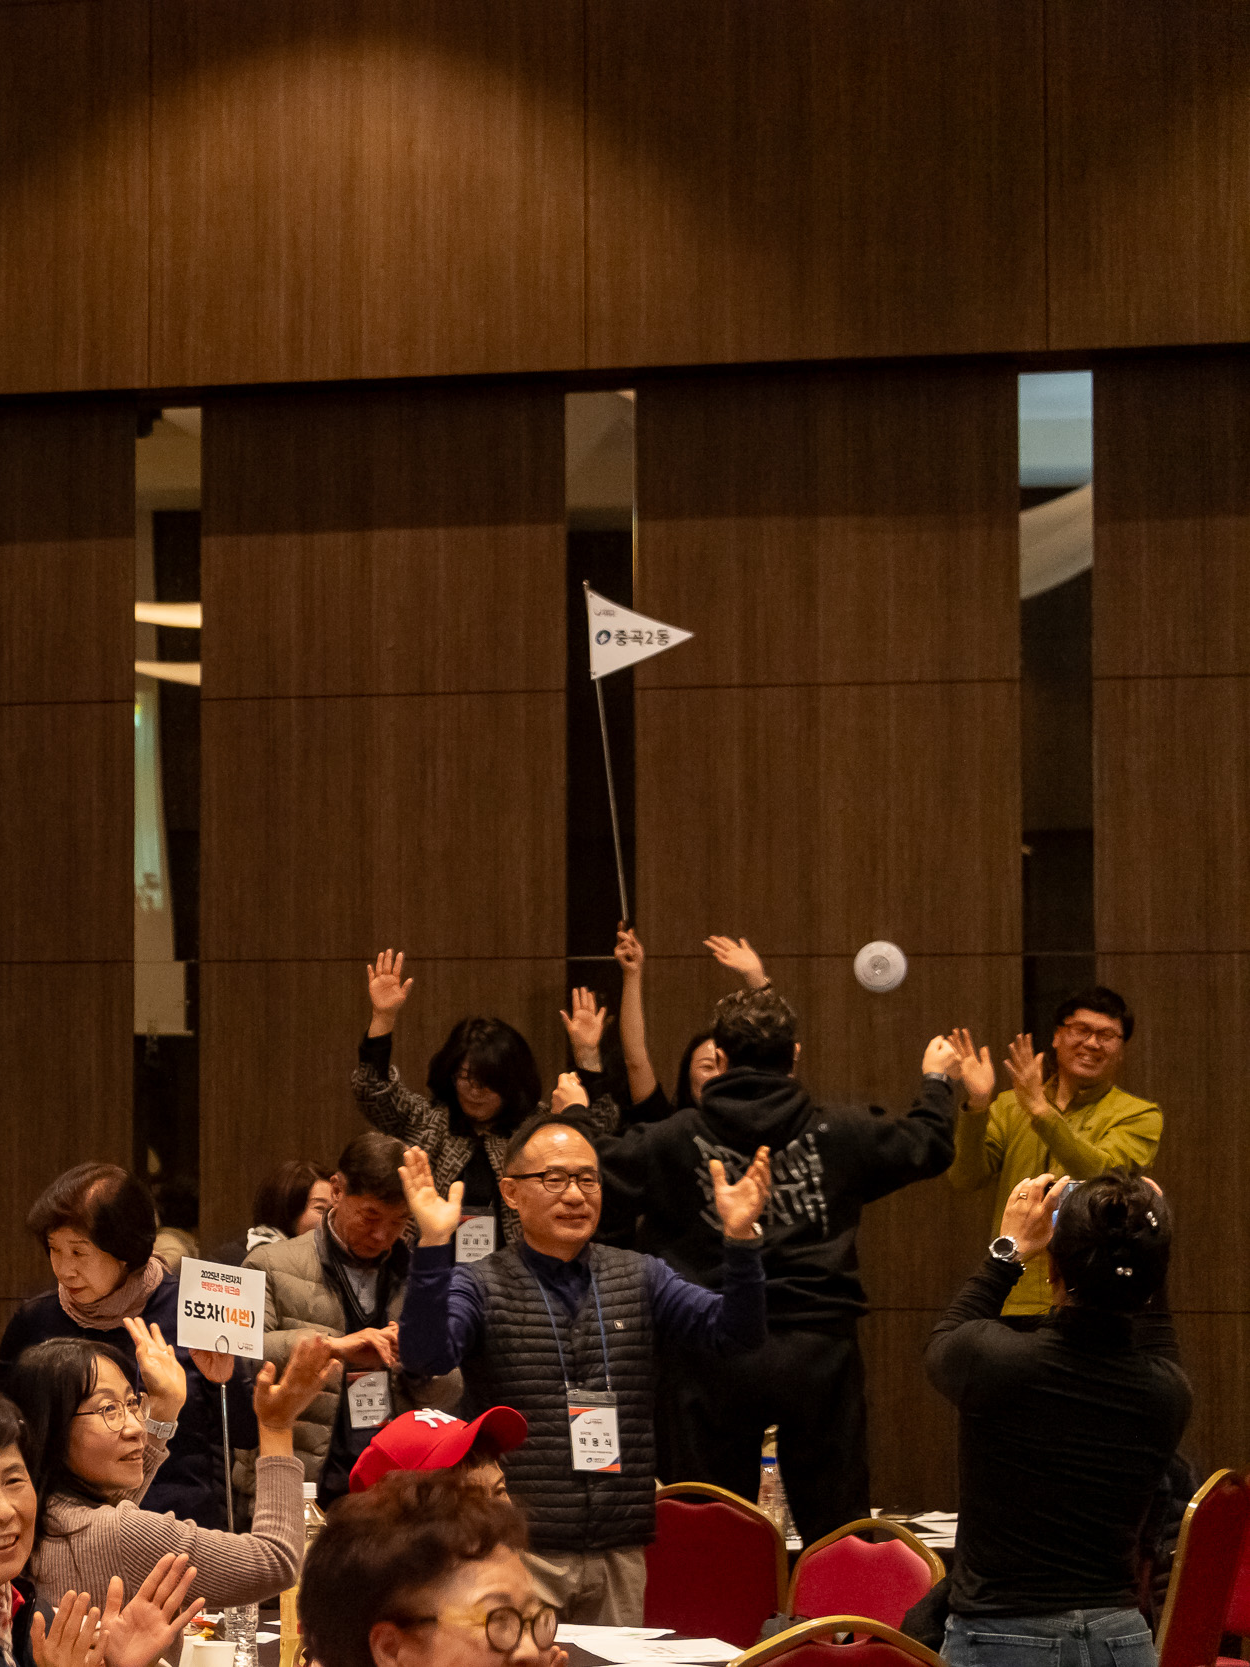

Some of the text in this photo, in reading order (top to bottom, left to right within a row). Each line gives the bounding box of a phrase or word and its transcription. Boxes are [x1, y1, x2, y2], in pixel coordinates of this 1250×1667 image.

[613, 629, 670, 647] 중곡2동
[200, 1269, 242, 1286] 2025년 주민자치
[183, 1299, 256, 1329] 5호차(14번)
